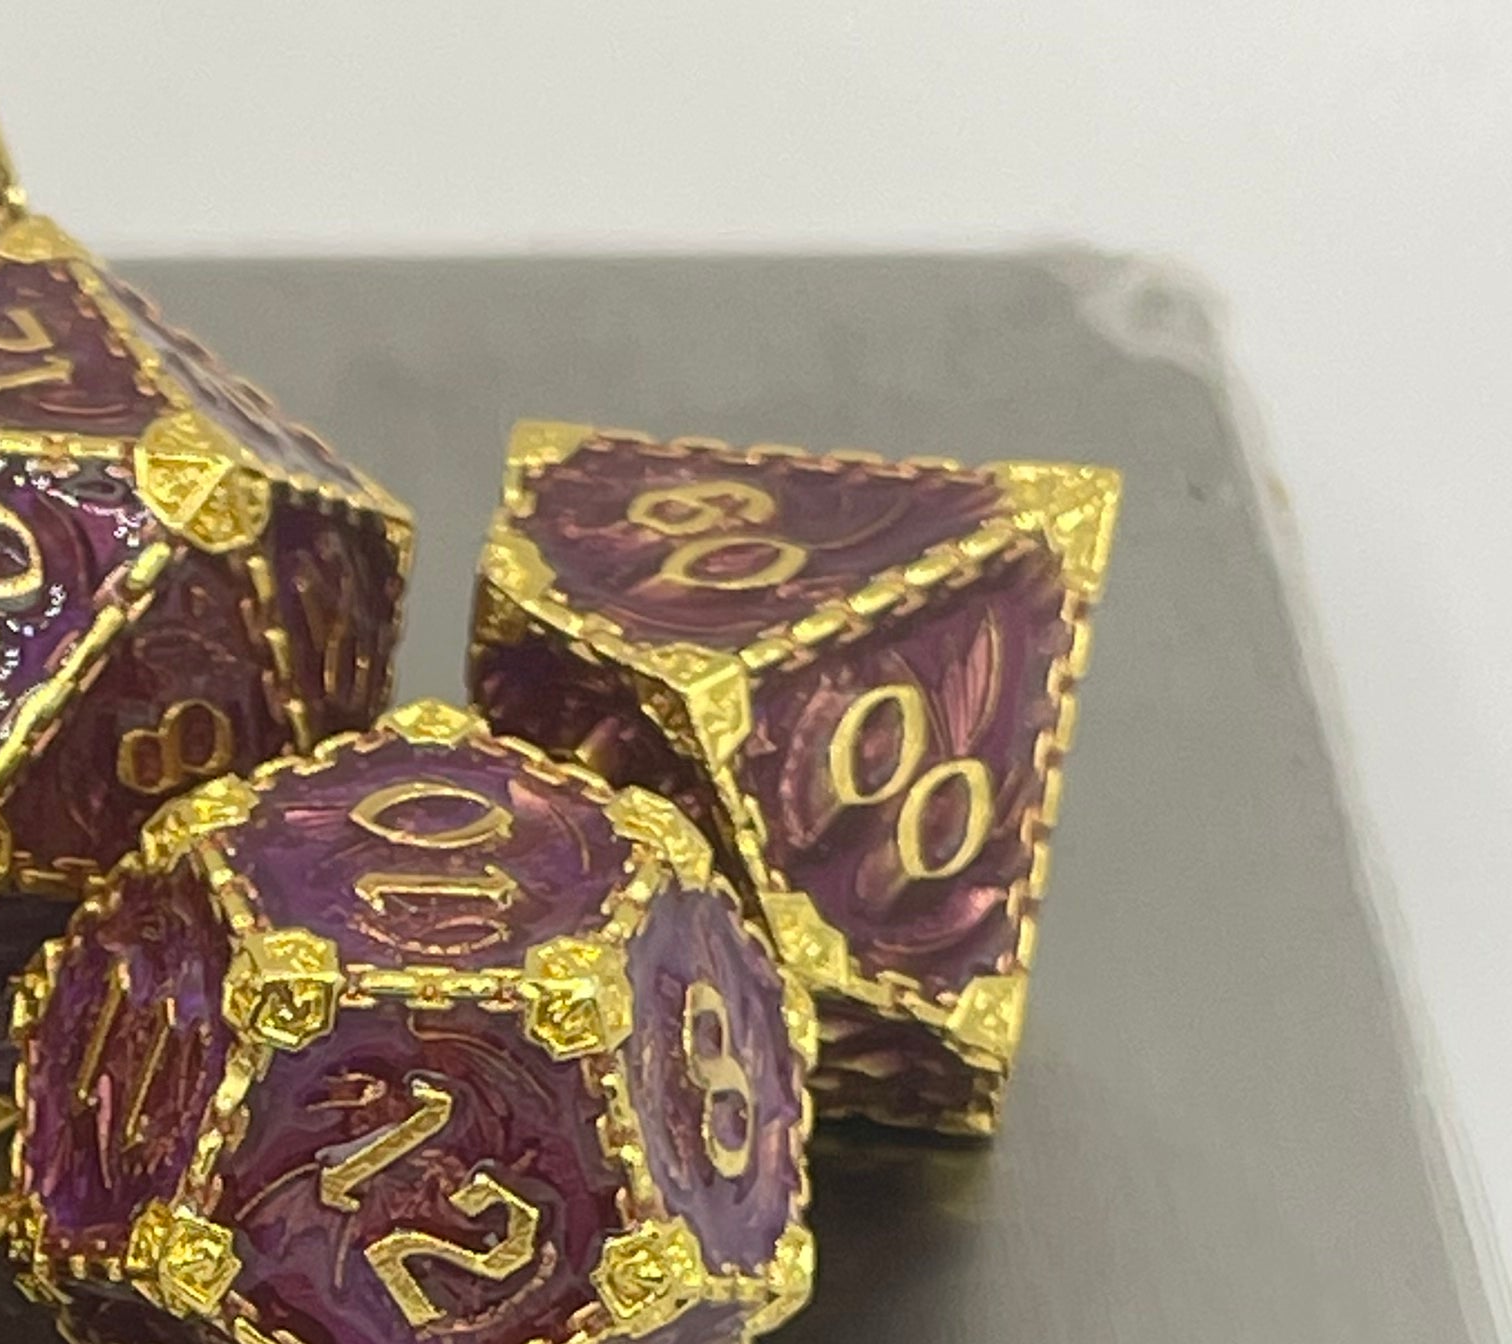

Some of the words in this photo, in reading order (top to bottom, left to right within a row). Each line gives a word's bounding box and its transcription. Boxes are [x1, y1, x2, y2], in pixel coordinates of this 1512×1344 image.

[348, 780, 522, 911] 10
[828, 683, 992, 880] 00
[319, 1072, 540, 1328] 12
